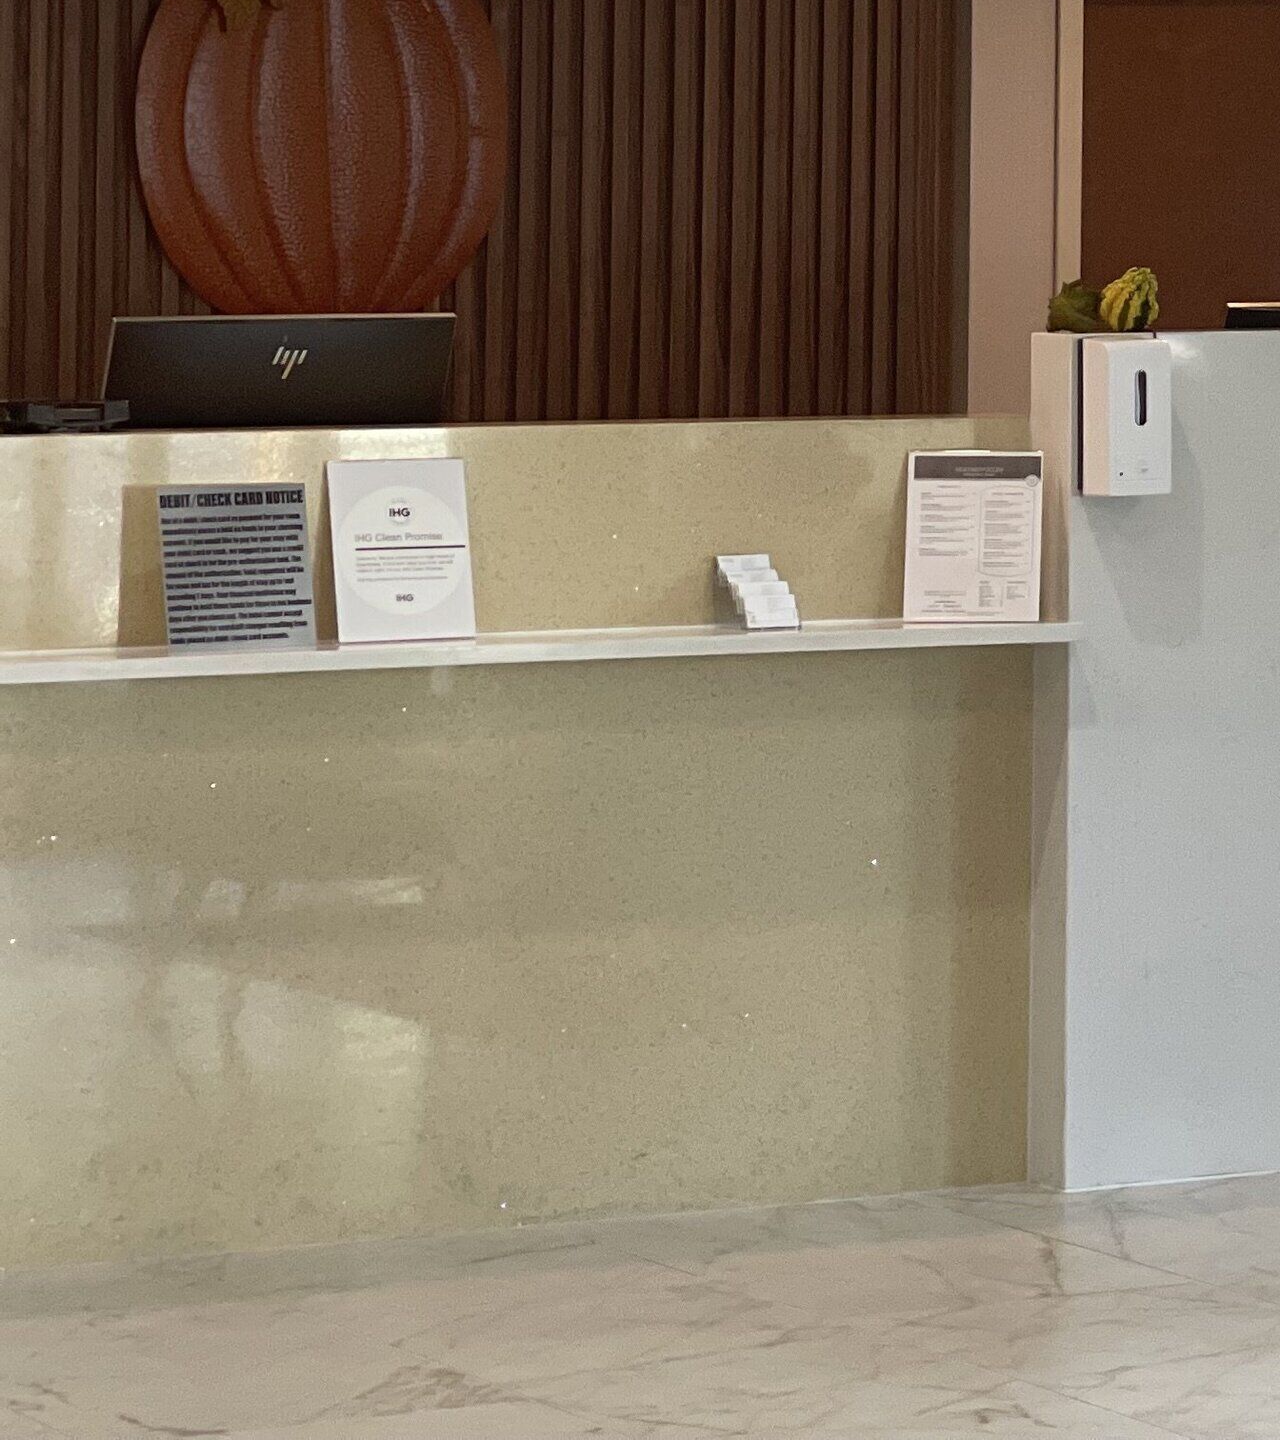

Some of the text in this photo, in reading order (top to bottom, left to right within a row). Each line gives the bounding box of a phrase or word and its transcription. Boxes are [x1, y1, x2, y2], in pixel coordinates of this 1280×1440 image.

[272, 336, 308, 380] hp
[234, 491, 264, 506] CARD
[265, 489, 304, 505] NOTICE
[388, 507, 411, 518] IHG
[354, 532, 443, 543] IHG Clean Promise
